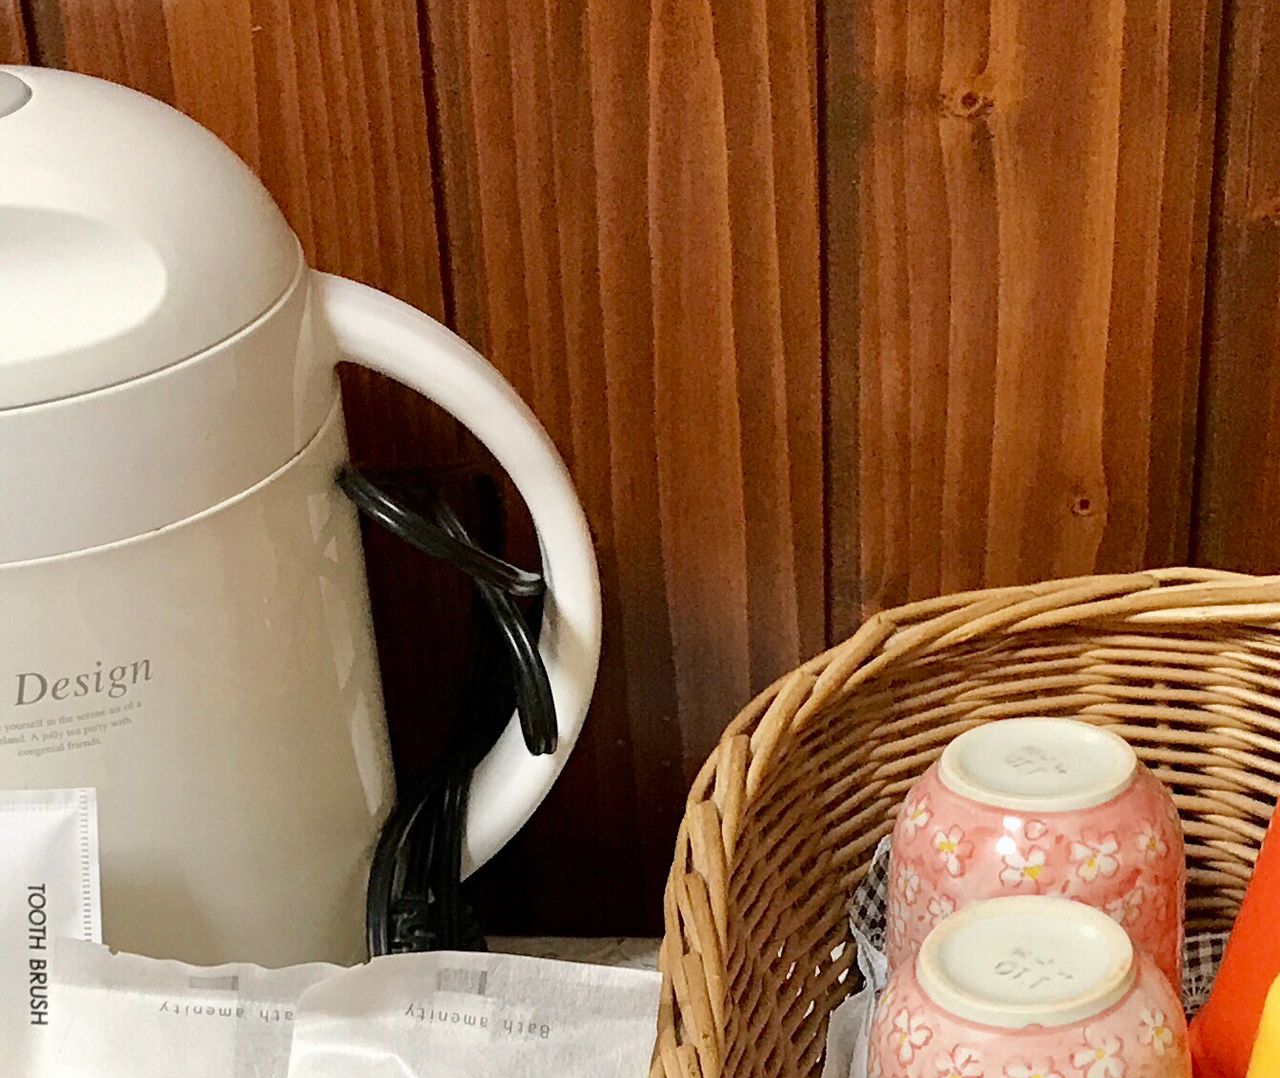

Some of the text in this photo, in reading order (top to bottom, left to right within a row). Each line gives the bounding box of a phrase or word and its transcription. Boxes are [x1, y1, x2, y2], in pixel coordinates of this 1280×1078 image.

[14, 658, 154, 706] Design
[4, 718, 43, 733] yourself
[58, 714, 74, 725] the
[31, 733, 40, 742] A
[27, 883, 49, 1025] TOOTH BRUSH
[159, 1001, 294, 1023] ath amenity
[404, 1003, 551, 1039] Bath amenity
